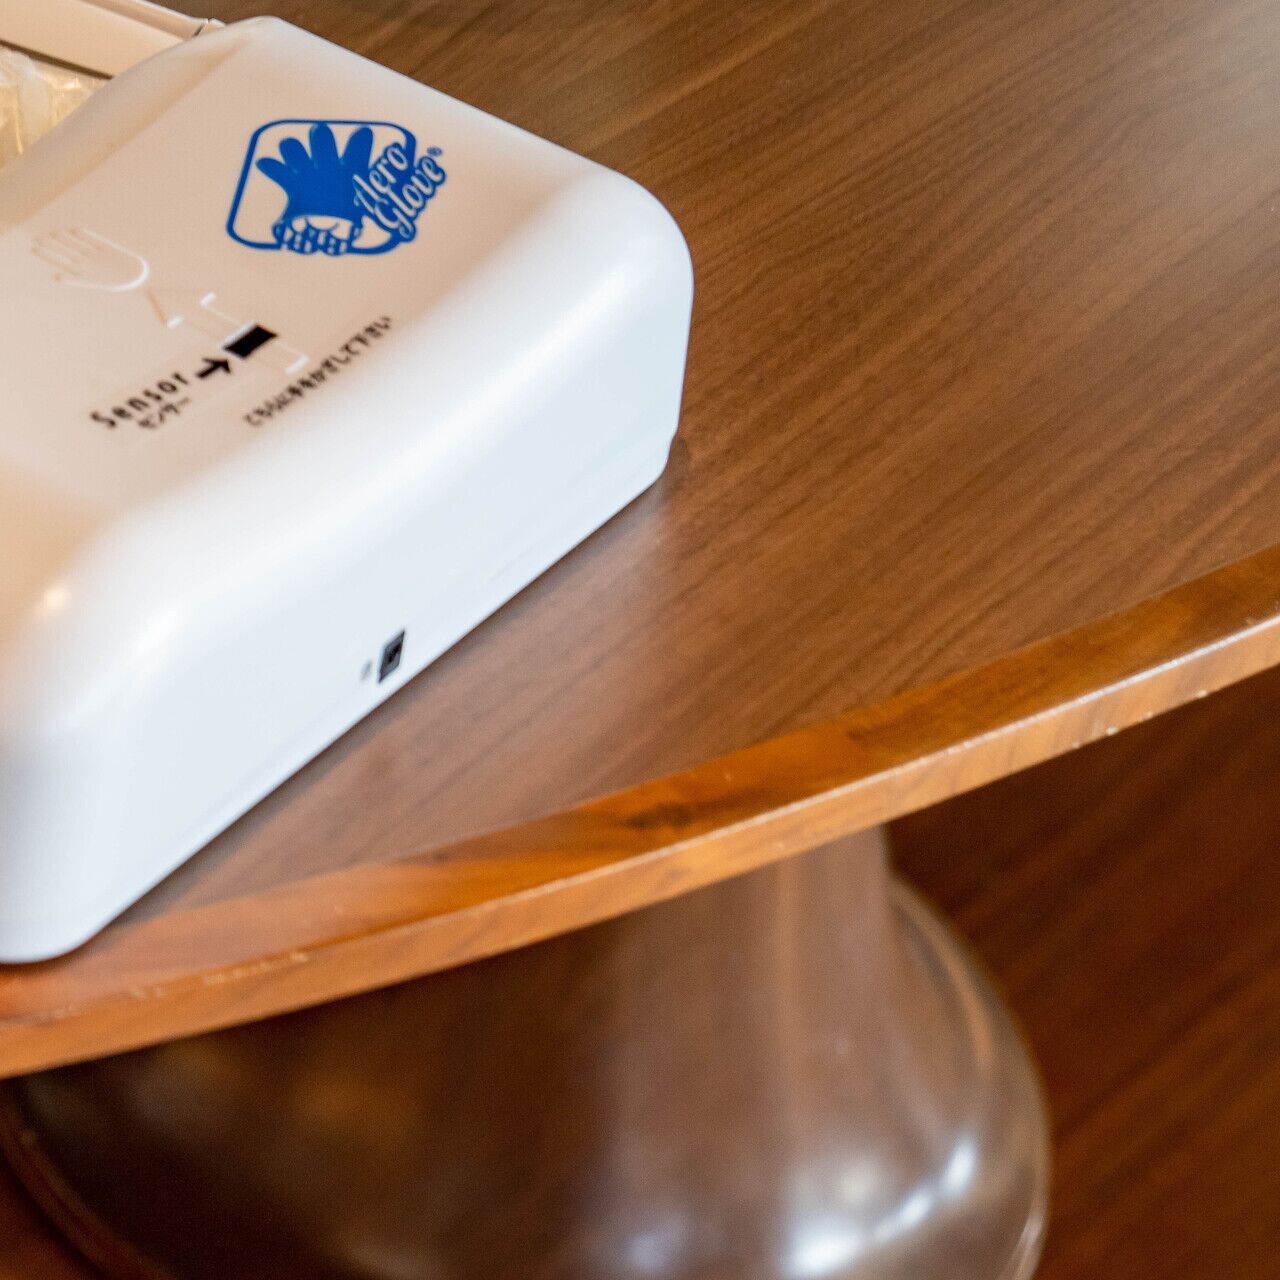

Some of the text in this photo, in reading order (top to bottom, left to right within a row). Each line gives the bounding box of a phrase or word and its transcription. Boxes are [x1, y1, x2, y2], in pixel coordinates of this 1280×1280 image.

[352, 146, 408, 215] Aero
[374, 157, 444, 239] Glove
[89, 370, 188, 429] Sensor
